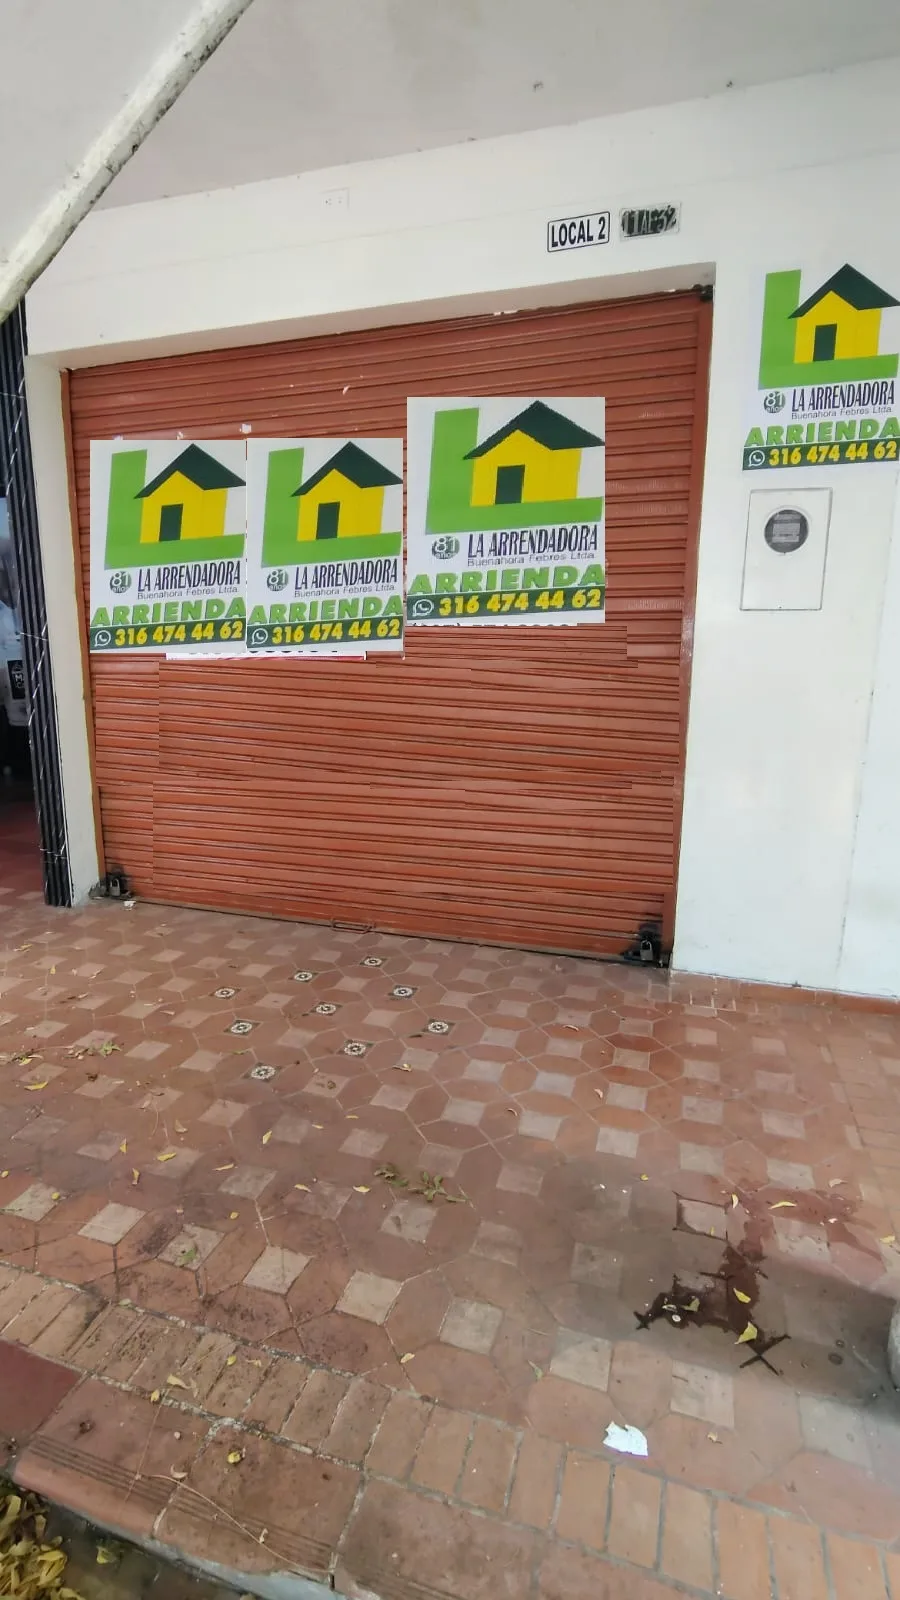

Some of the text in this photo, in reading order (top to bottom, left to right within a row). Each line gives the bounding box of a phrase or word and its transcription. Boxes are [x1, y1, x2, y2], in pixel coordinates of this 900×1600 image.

[551, 217, 606, 248] LOCAL 2
[792, 380, 894, 412] LA ARRENDADORA
[791, 410, 836, 420] Buenahora
[840, 408, 869, 416] Febres
[745, 417, 900, 447] ARRIENDA
[769, 440, 897, 466] 316 474 44 62
[468, 524, 597, 558] LA ARRENDADORA
[295, 558, 397, 590] LA ARRENDADORA
[467, 556, 524, 567] Buenahora
[529, 554, 566, 563] Febres
[138, 560, 240, 592] LA ARRENDADORA
[409, 564, 606, 595] ARRIENDA
[137, 590, 182, 600] Buenahora
[186, 588, 215, 596] Febres
[294, 588, 339, 598] Buenahora
[343, 586, 372, 594] Febres
[439, 589, 601, 616] 316 474 44 62
[91, 597, 246, 627] ARRIENDA
[248, 595, 403, 625] ARRIENDA
[115, 620, 243, 646] 316 474 44 62
[272, 618, 400, 644] 316 474 44 62
